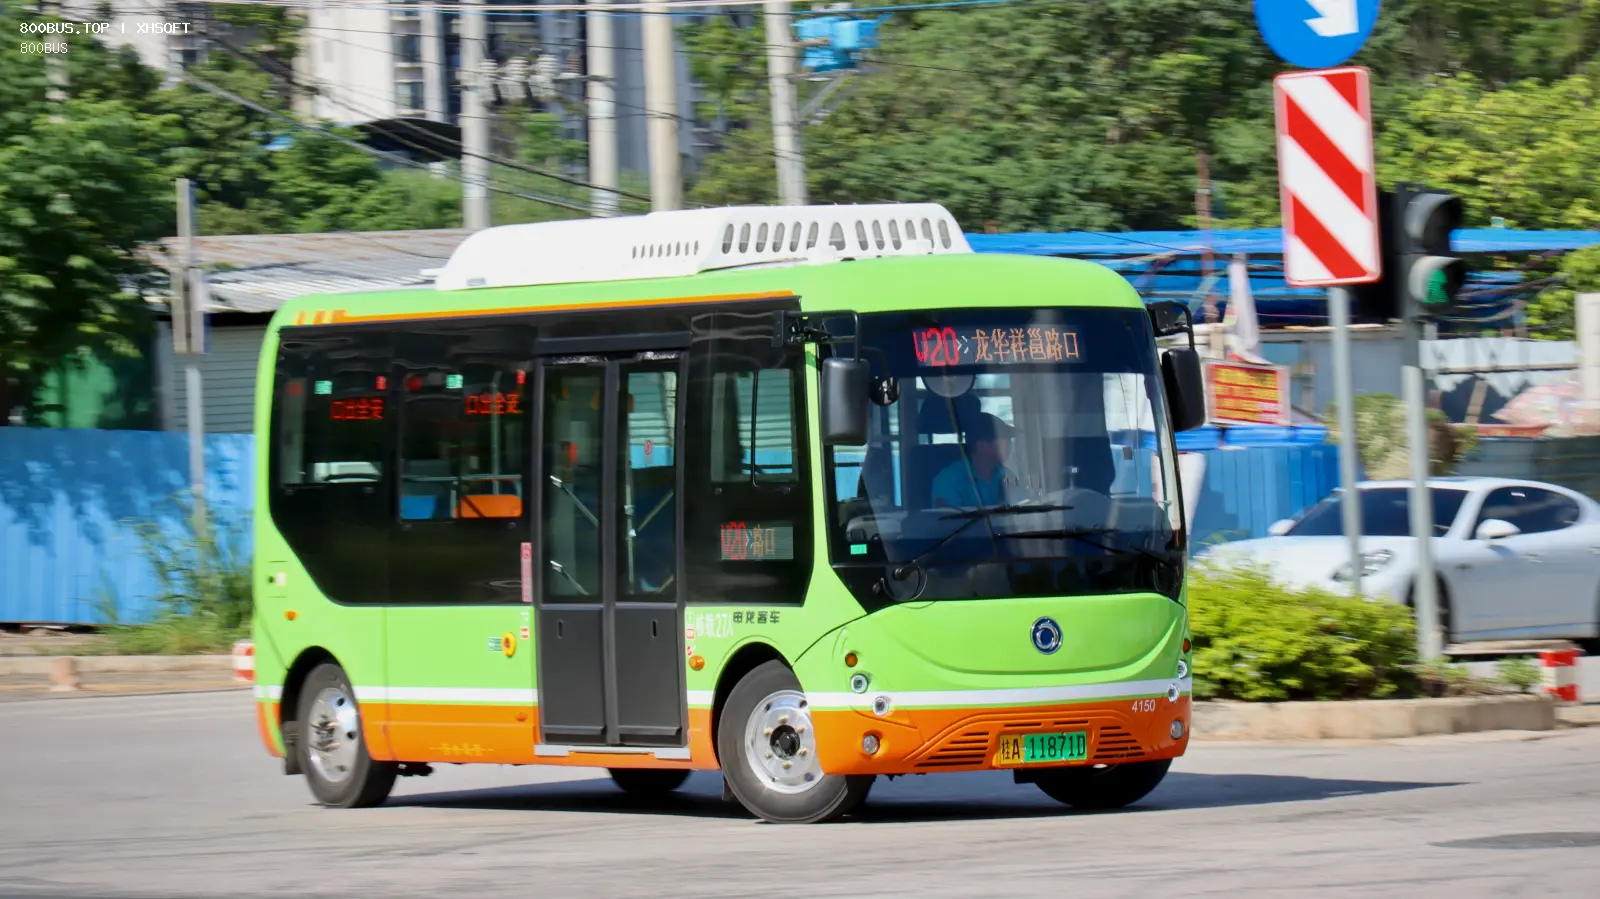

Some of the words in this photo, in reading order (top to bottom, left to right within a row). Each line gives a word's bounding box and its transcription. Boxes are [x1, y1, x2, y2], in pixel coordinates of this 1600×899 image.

[912, 326, 960, 367] U20
[971, 327, 1080, 363] 龙华祥邕路口
[732, 610, 781, 625] 申龙客车
[1131, 699, 1156, 713] 4150
